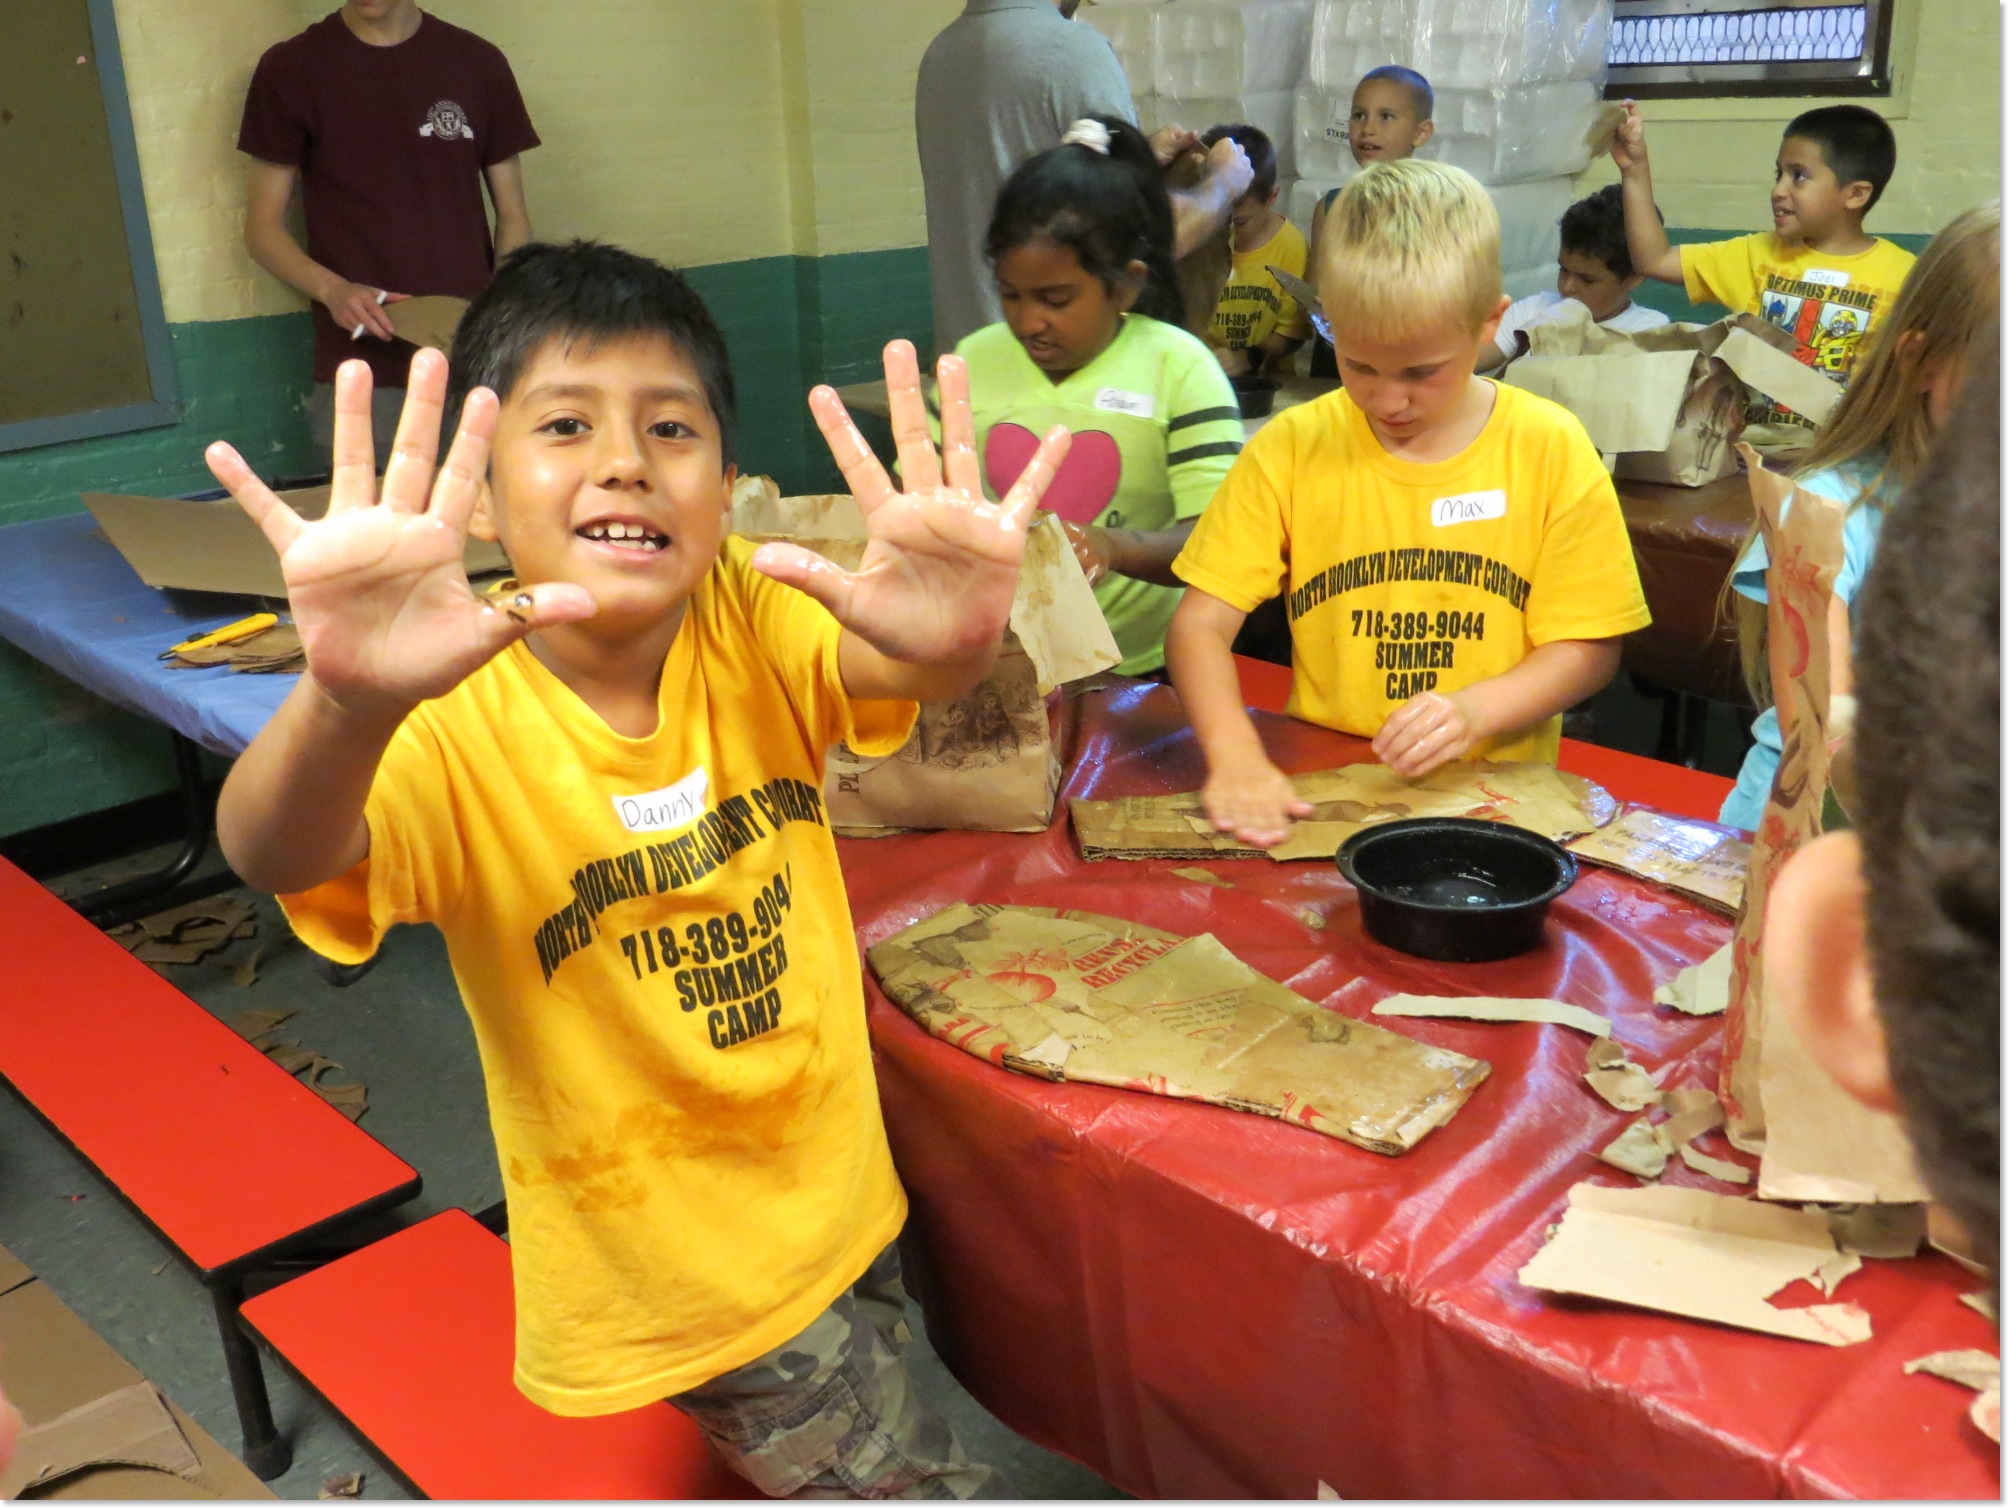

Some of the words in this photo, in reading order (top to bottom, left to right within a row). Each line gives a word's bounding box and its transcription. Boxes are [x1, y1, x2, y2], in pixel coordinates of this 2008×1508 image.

[1766, 274, 1828, 300] OPTIMUS
[1828, 286, 1878, 310] PRIME
[1440, 499, 1485, 522] Max
[1290, 570, 1327, 623] NORTH
[1387, 548, 1483, 588] DEVELOPMENT
[1483, 557, 1532, 613] CORRAT
[1351, 609, 1485, 641] 718-389-9044
[1375, 640, 1455, 671] SUMMER
[1385, 670, 1438, 701] CAMP
[621, 790, 696, 829] Danny
[569, 848, 651, 935] OOKLYN
[645, 794, 767, 894] DEVELOPENT
[619, 861, 793, 981] 718-389-904
[673, 932, 789, 1013] SUMMER
[706, 986, 783, 1051] CAMP
